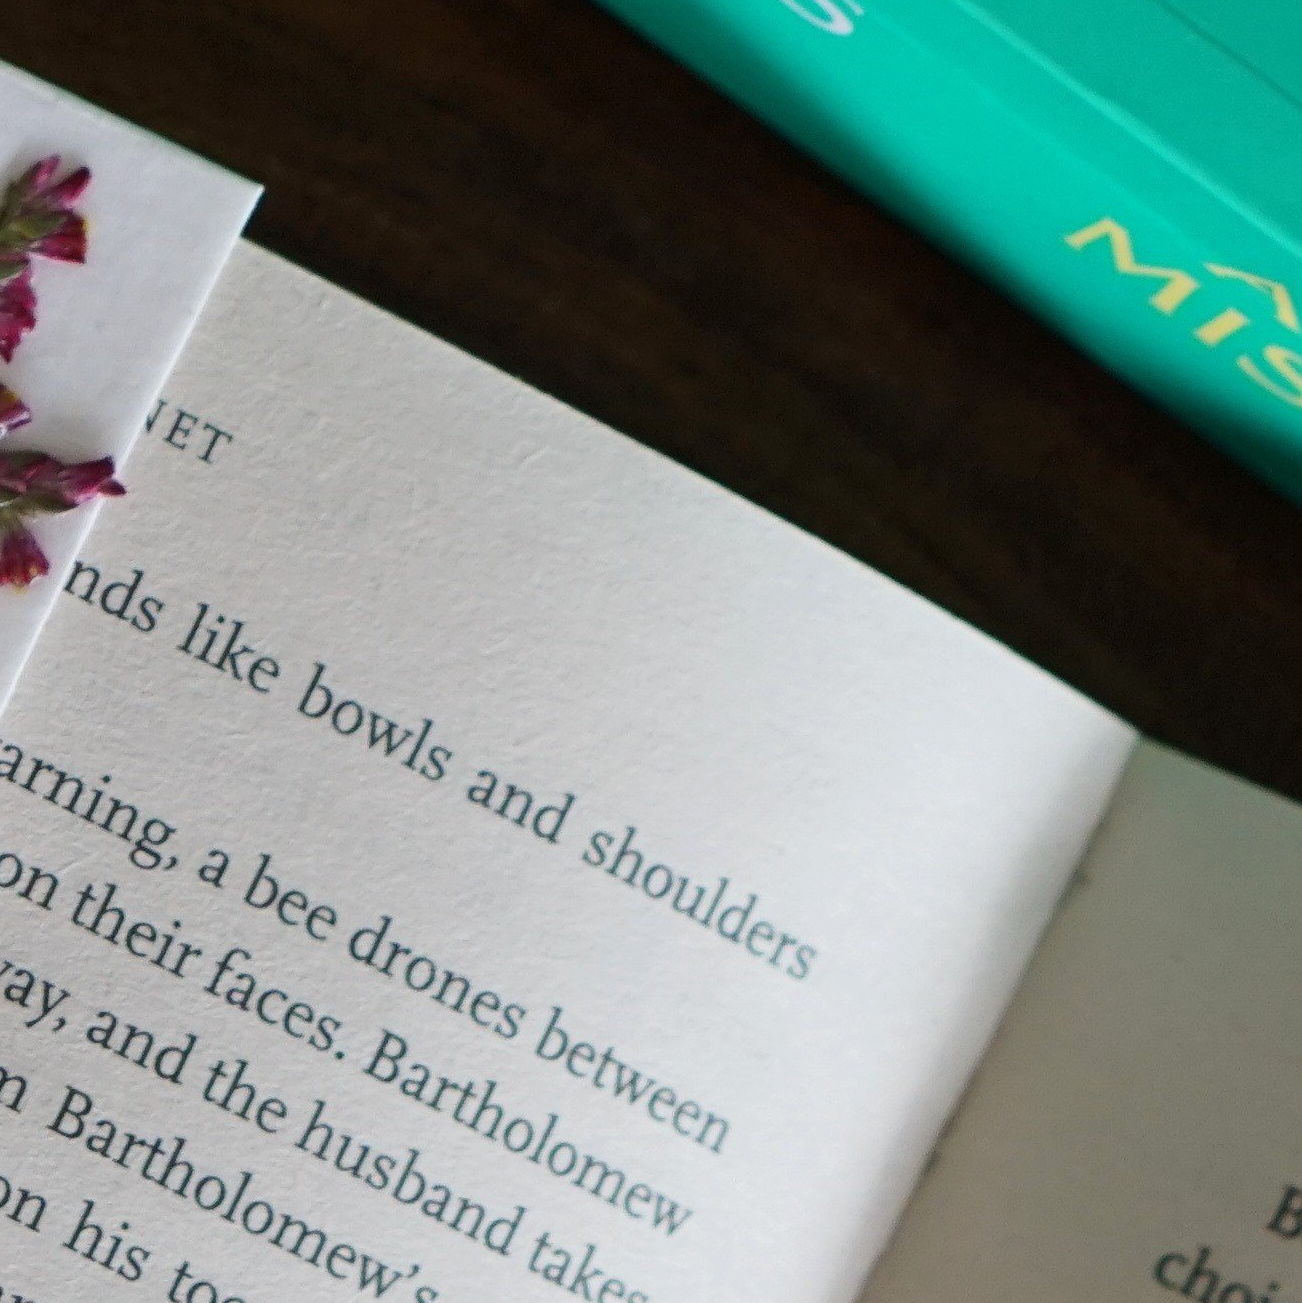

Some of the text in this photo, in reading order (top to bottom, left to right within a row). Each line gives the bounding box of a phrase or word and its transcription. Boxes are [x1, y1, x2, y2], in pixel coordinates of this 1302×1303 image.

[177, 603, 815, 978] like bowls and shoulders
[86, 1011, 198, 1085] and
[203, 1059, 287, 1134] the
[295, 1099, 526, 1256] husband
[197, 849, 728, 1153] a bee drones between
